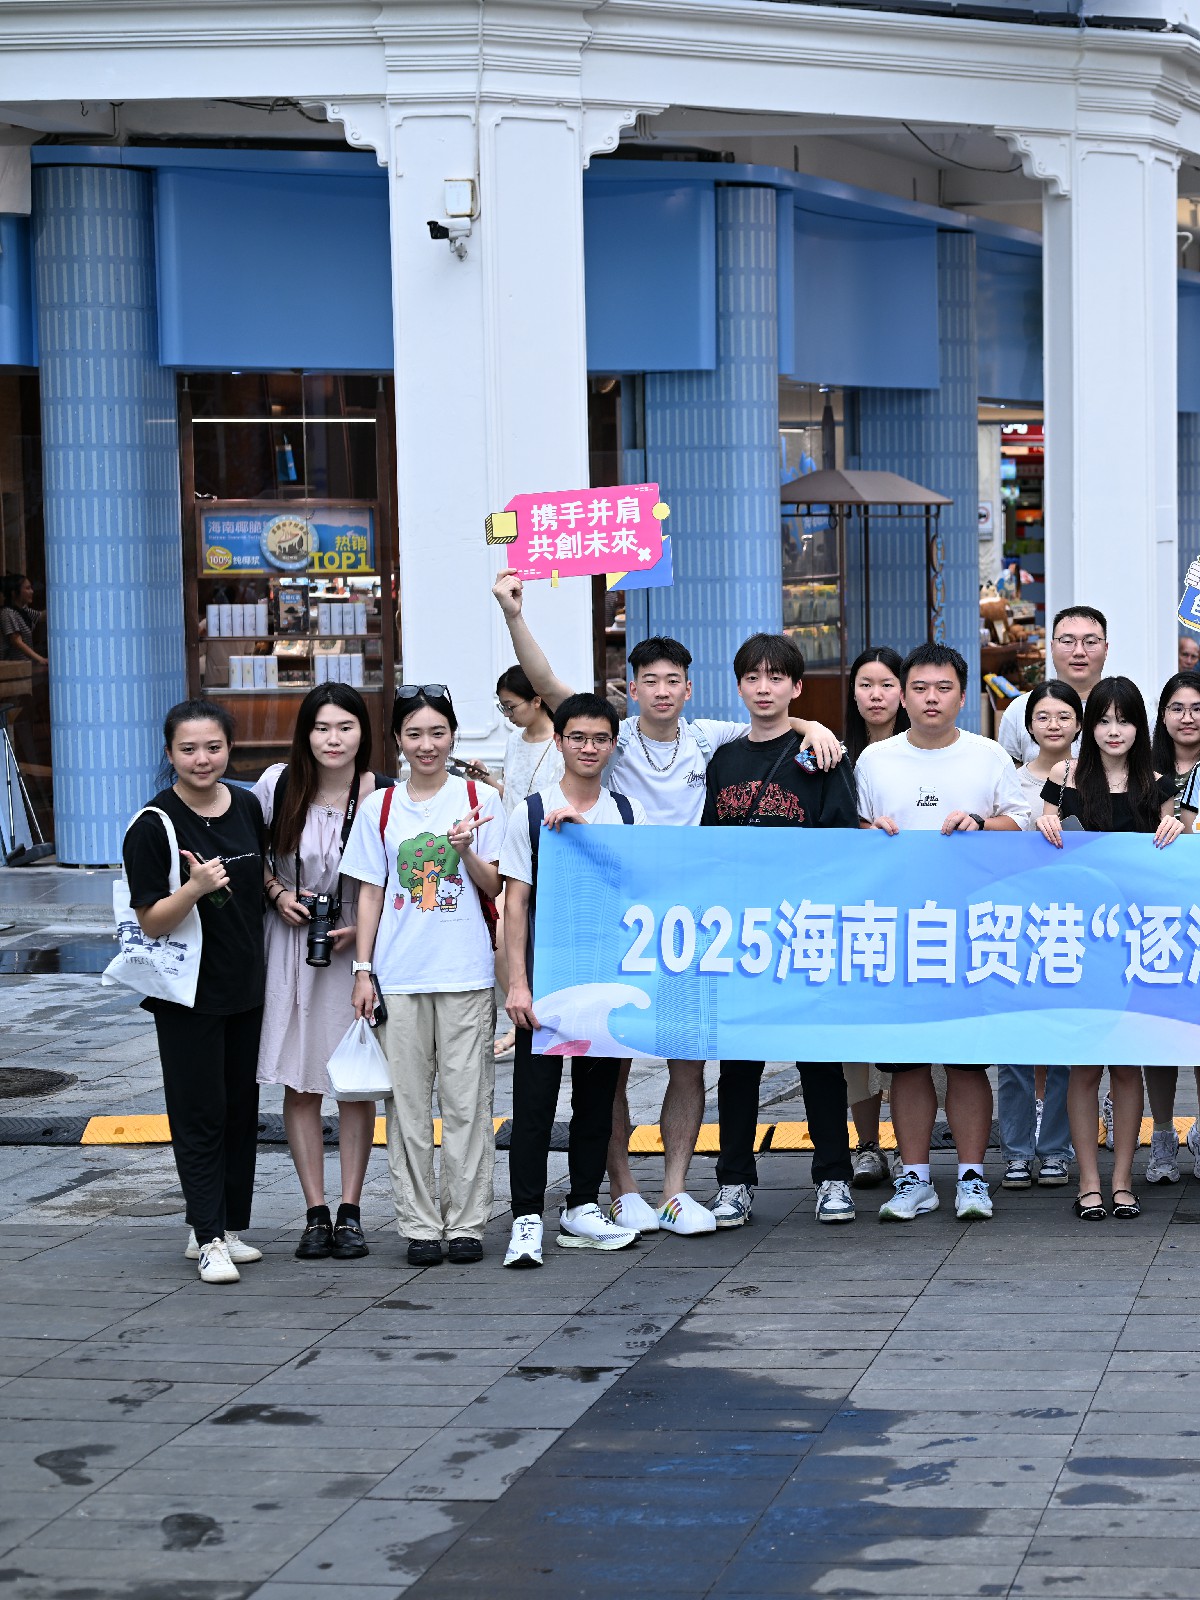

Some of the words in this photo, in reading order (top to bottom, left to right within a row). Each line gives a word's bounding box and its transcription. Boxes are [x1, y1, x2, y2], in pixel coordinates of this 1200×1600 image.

[531, 496, 641, 532] 携手并肩
[335, 535, 367, 551] 热销
[527, 527, 639, 562] 共創未來
[309, 552, 370, 570] TOP1
